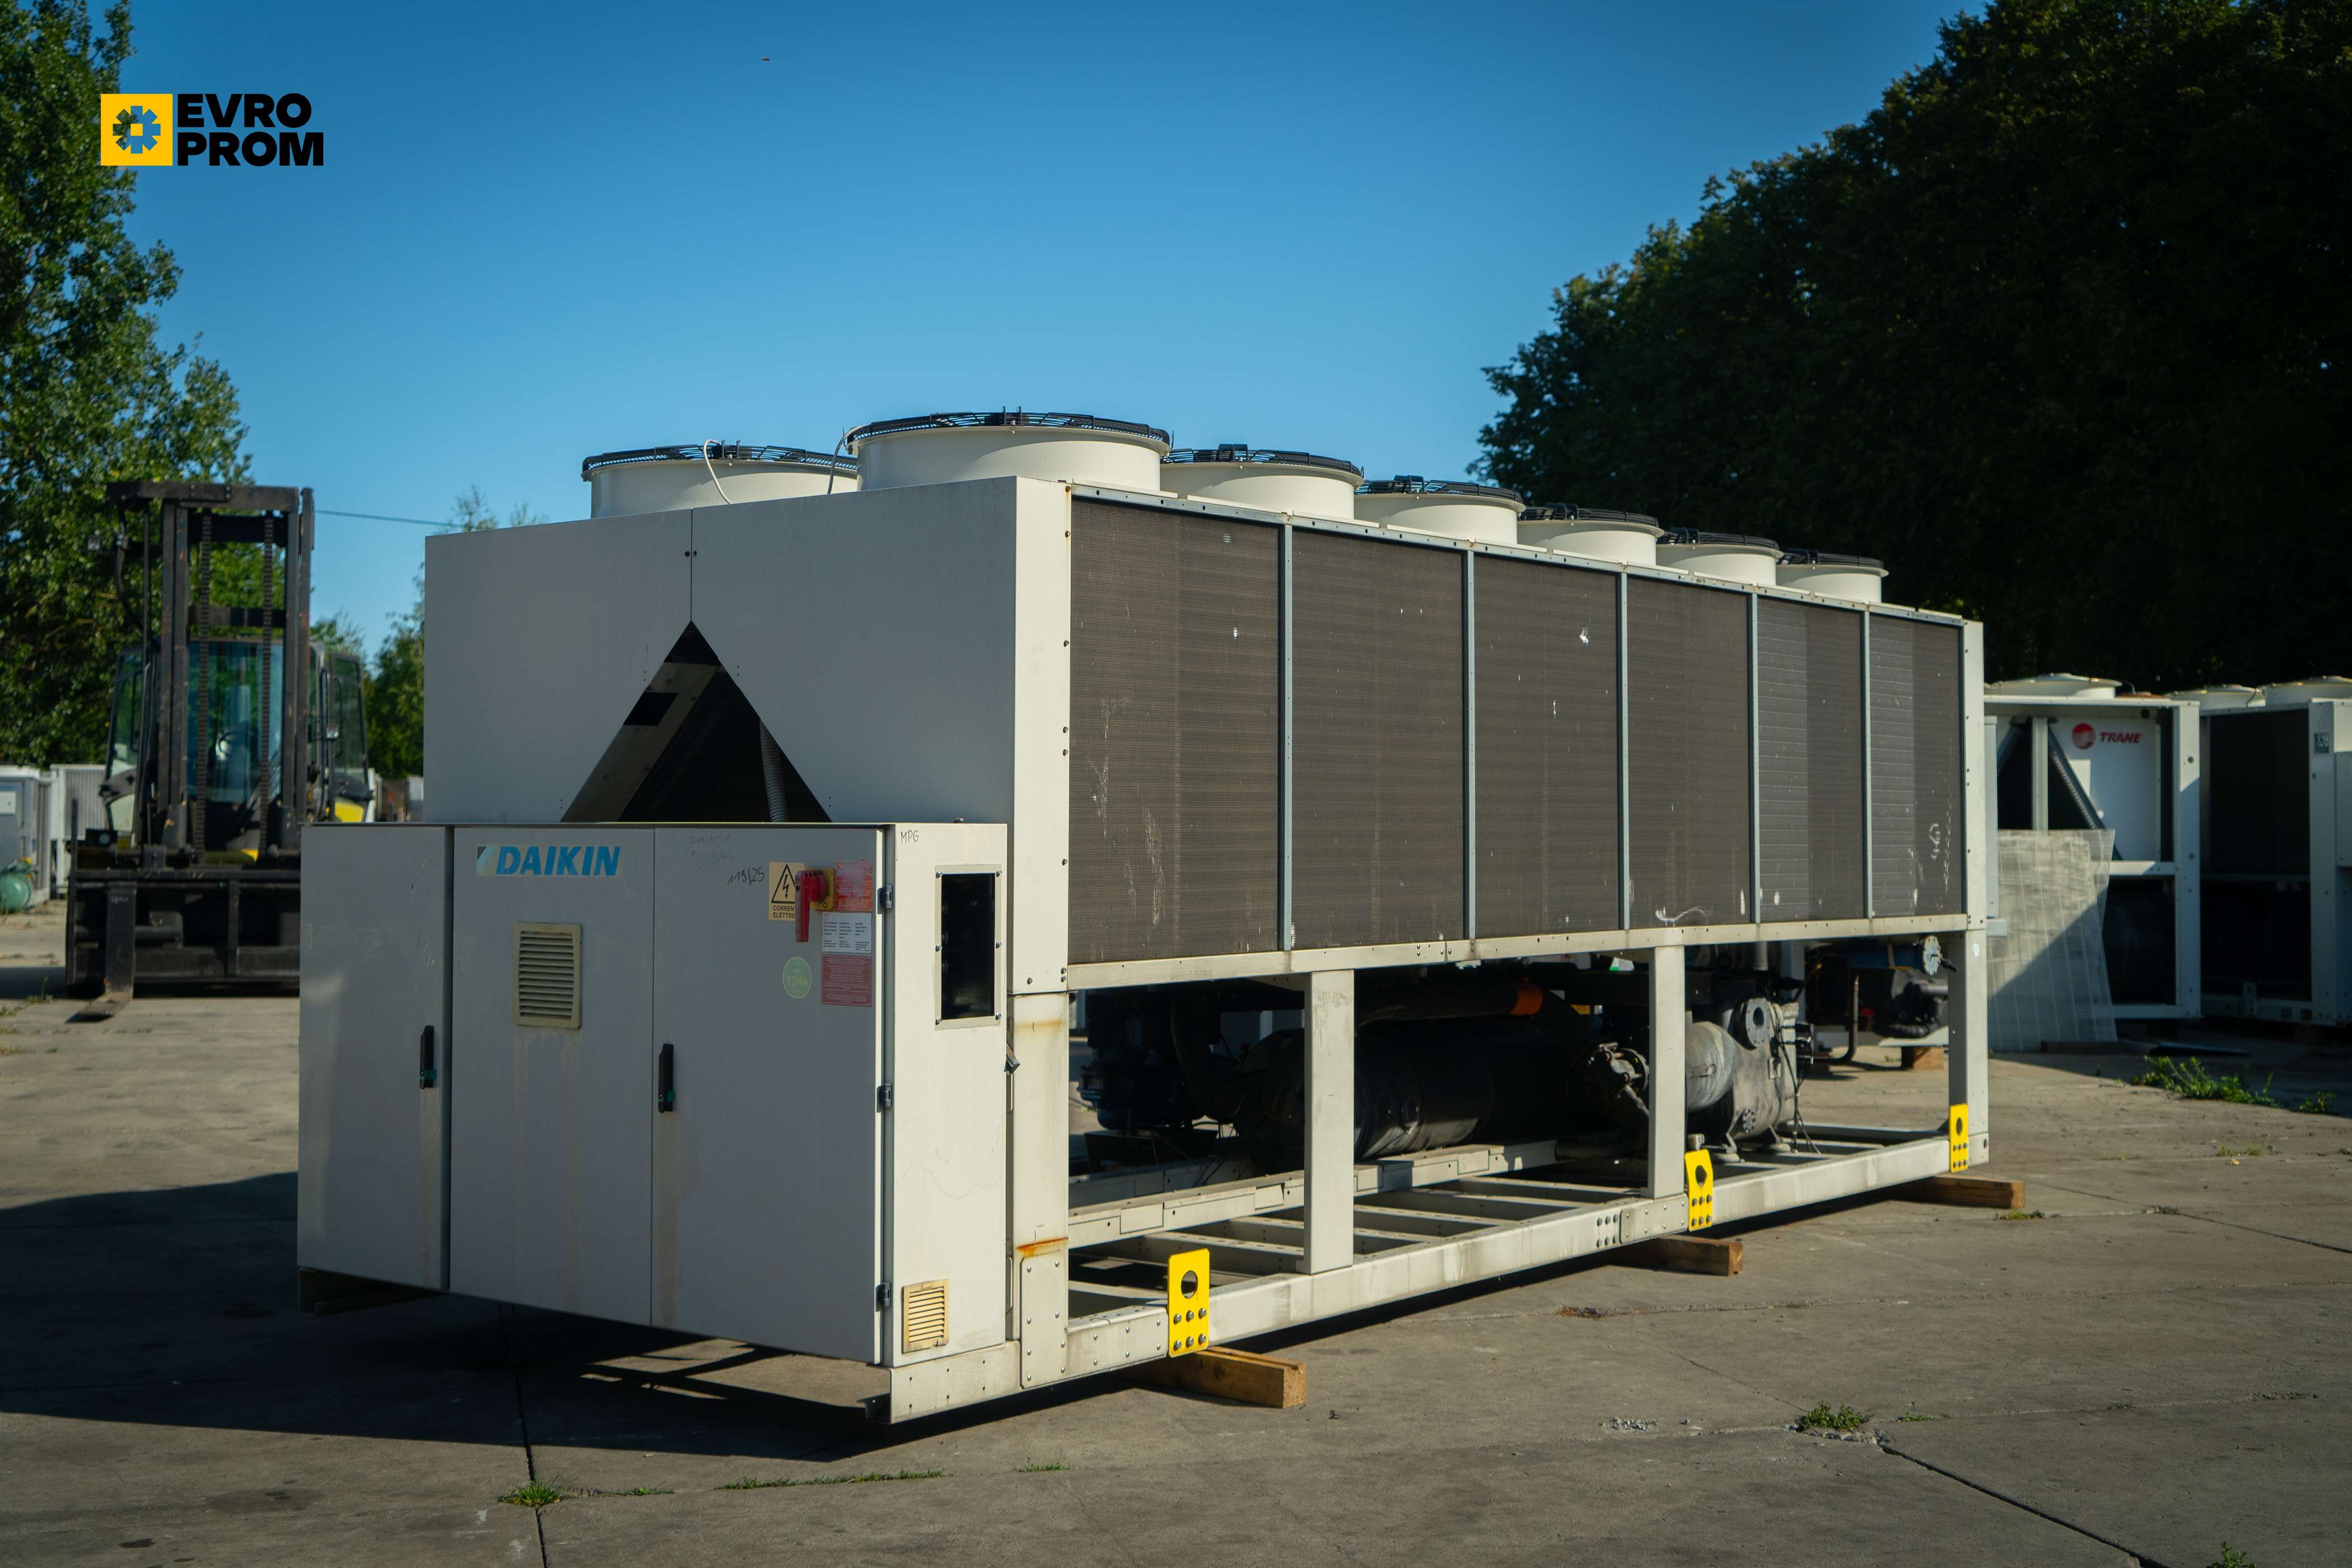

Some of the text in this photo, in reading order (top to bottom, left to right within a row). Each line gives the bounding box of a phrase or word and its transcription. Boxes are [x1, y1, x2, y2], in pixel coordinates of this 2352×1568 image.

[2100, 732, 2141, 744] TRANE
[901, 829, 919, 844] MPG
[496, 846, 620, 876] DAIKIN
[787, 976, 808, 987] 134a
